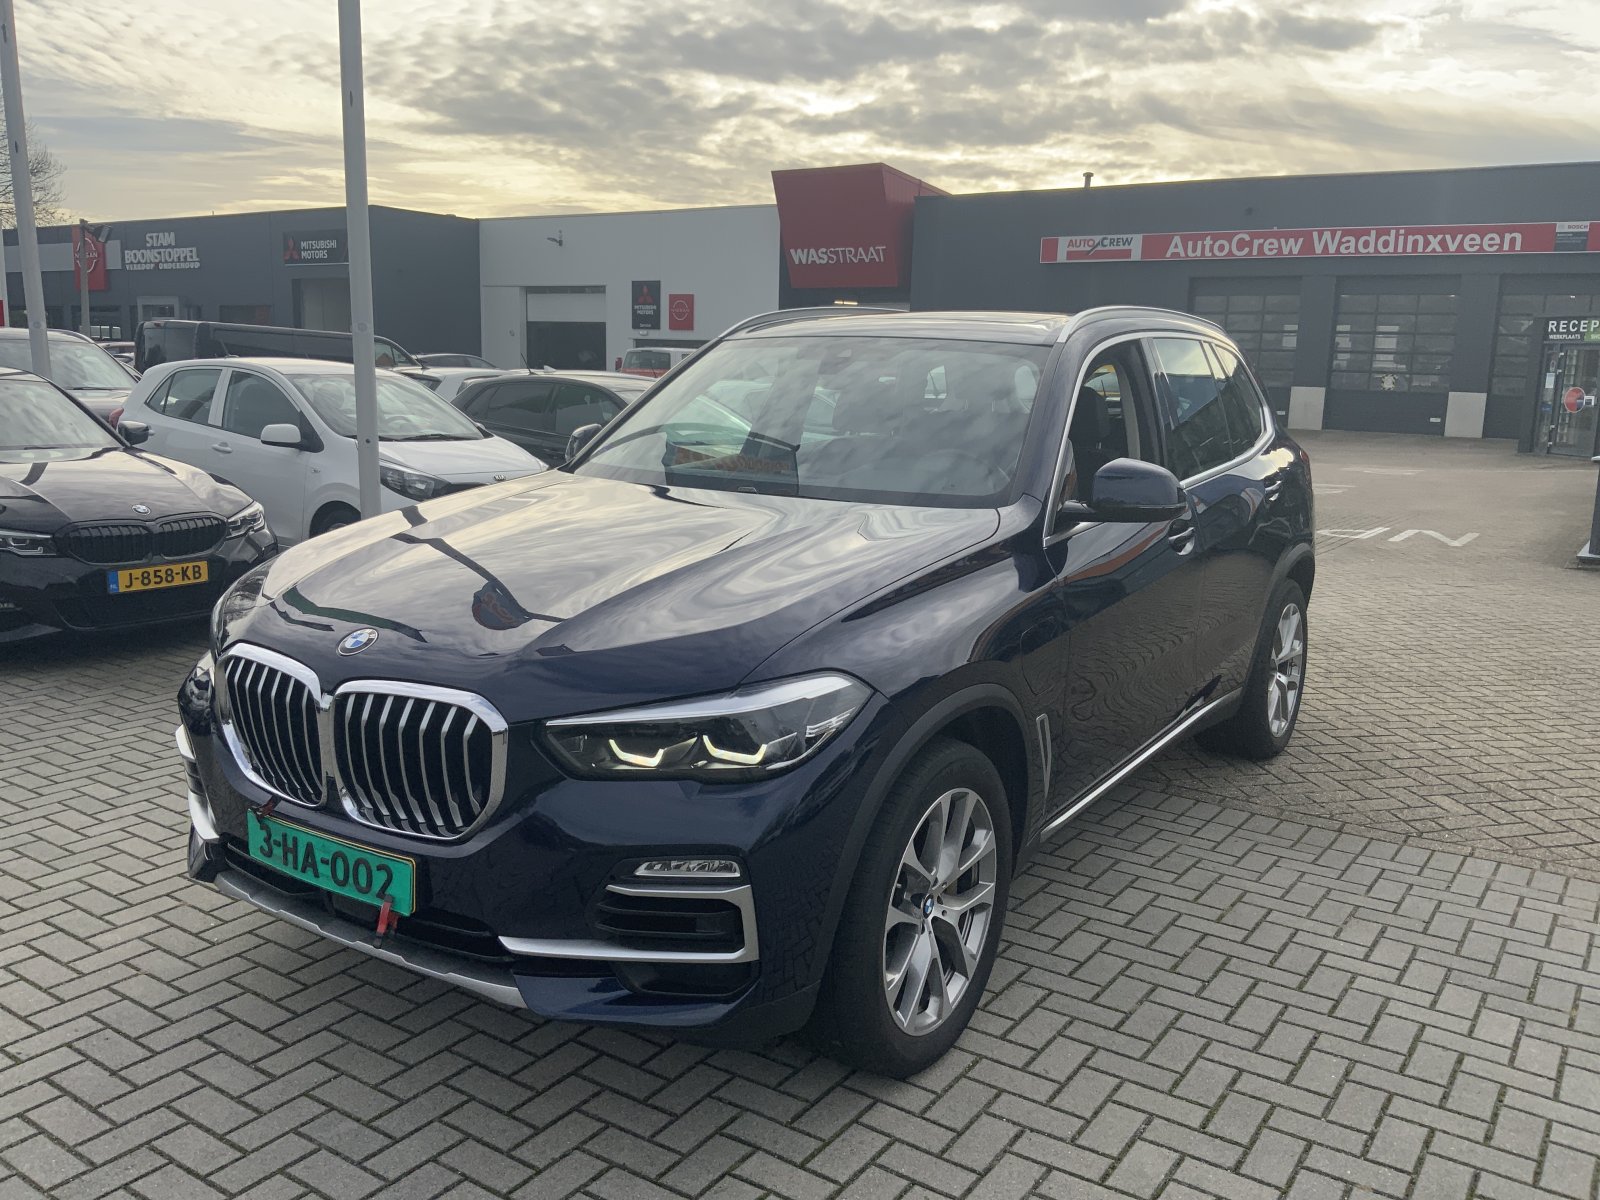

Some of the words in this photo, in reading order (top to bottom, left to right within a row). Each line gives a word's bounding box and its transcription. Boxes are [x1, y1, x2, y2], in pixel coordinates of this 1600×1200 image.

[145, 231, 176, 247] STAM
[300, 239, 337, 250] MITSUBISHI
[1165, 233, 1304, 258] AutoCrew
[1311, 229, 1523, 254] Waddinxveen
[124, 247, 200, 264] BOONSTOPPEL
[301, 250, 328, 259] MOTORS
[789, 245, 887, 265] WASSTRAAT
[1548, 319, 1600, 332] RECEP
[124, 564, 203, 589] J-858-KB
[258, 821, 394, 900] 3-HA-002
